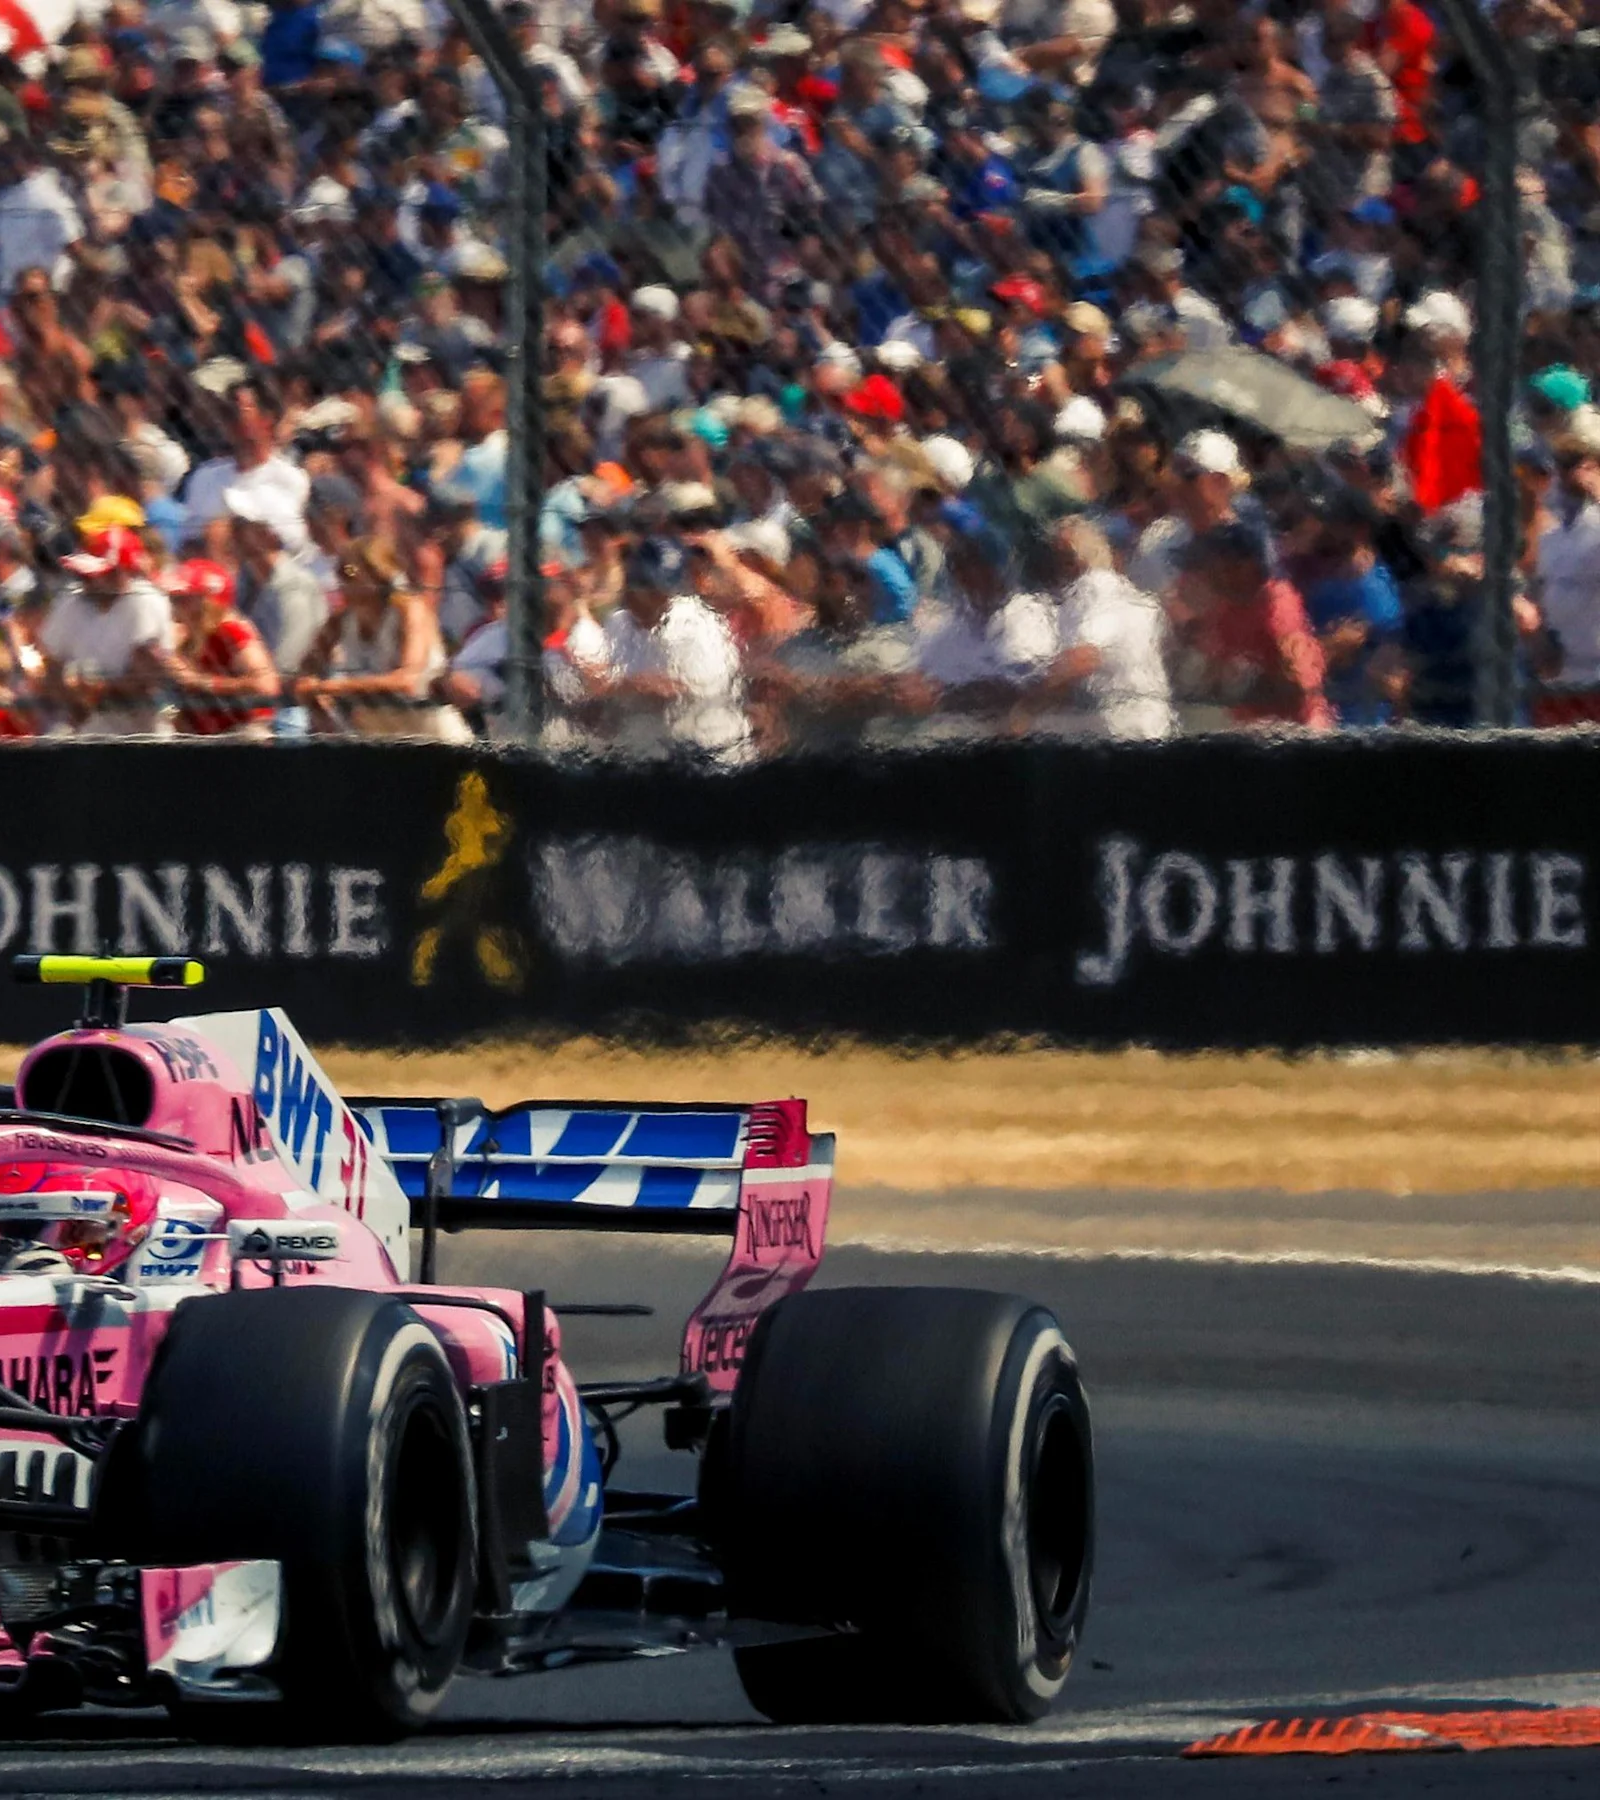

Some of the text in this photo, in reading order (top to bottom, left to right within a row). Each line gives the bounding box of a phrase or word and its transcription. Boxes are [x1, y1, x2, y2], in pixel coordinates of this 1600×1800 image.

[1077, 837, 1585, 985] JOHNNIE
[255, 1008, 332, 1193] BWT
[141, 1264, 199, 1276] BWT
[275, 1235, 338, 1249] PEMEX
